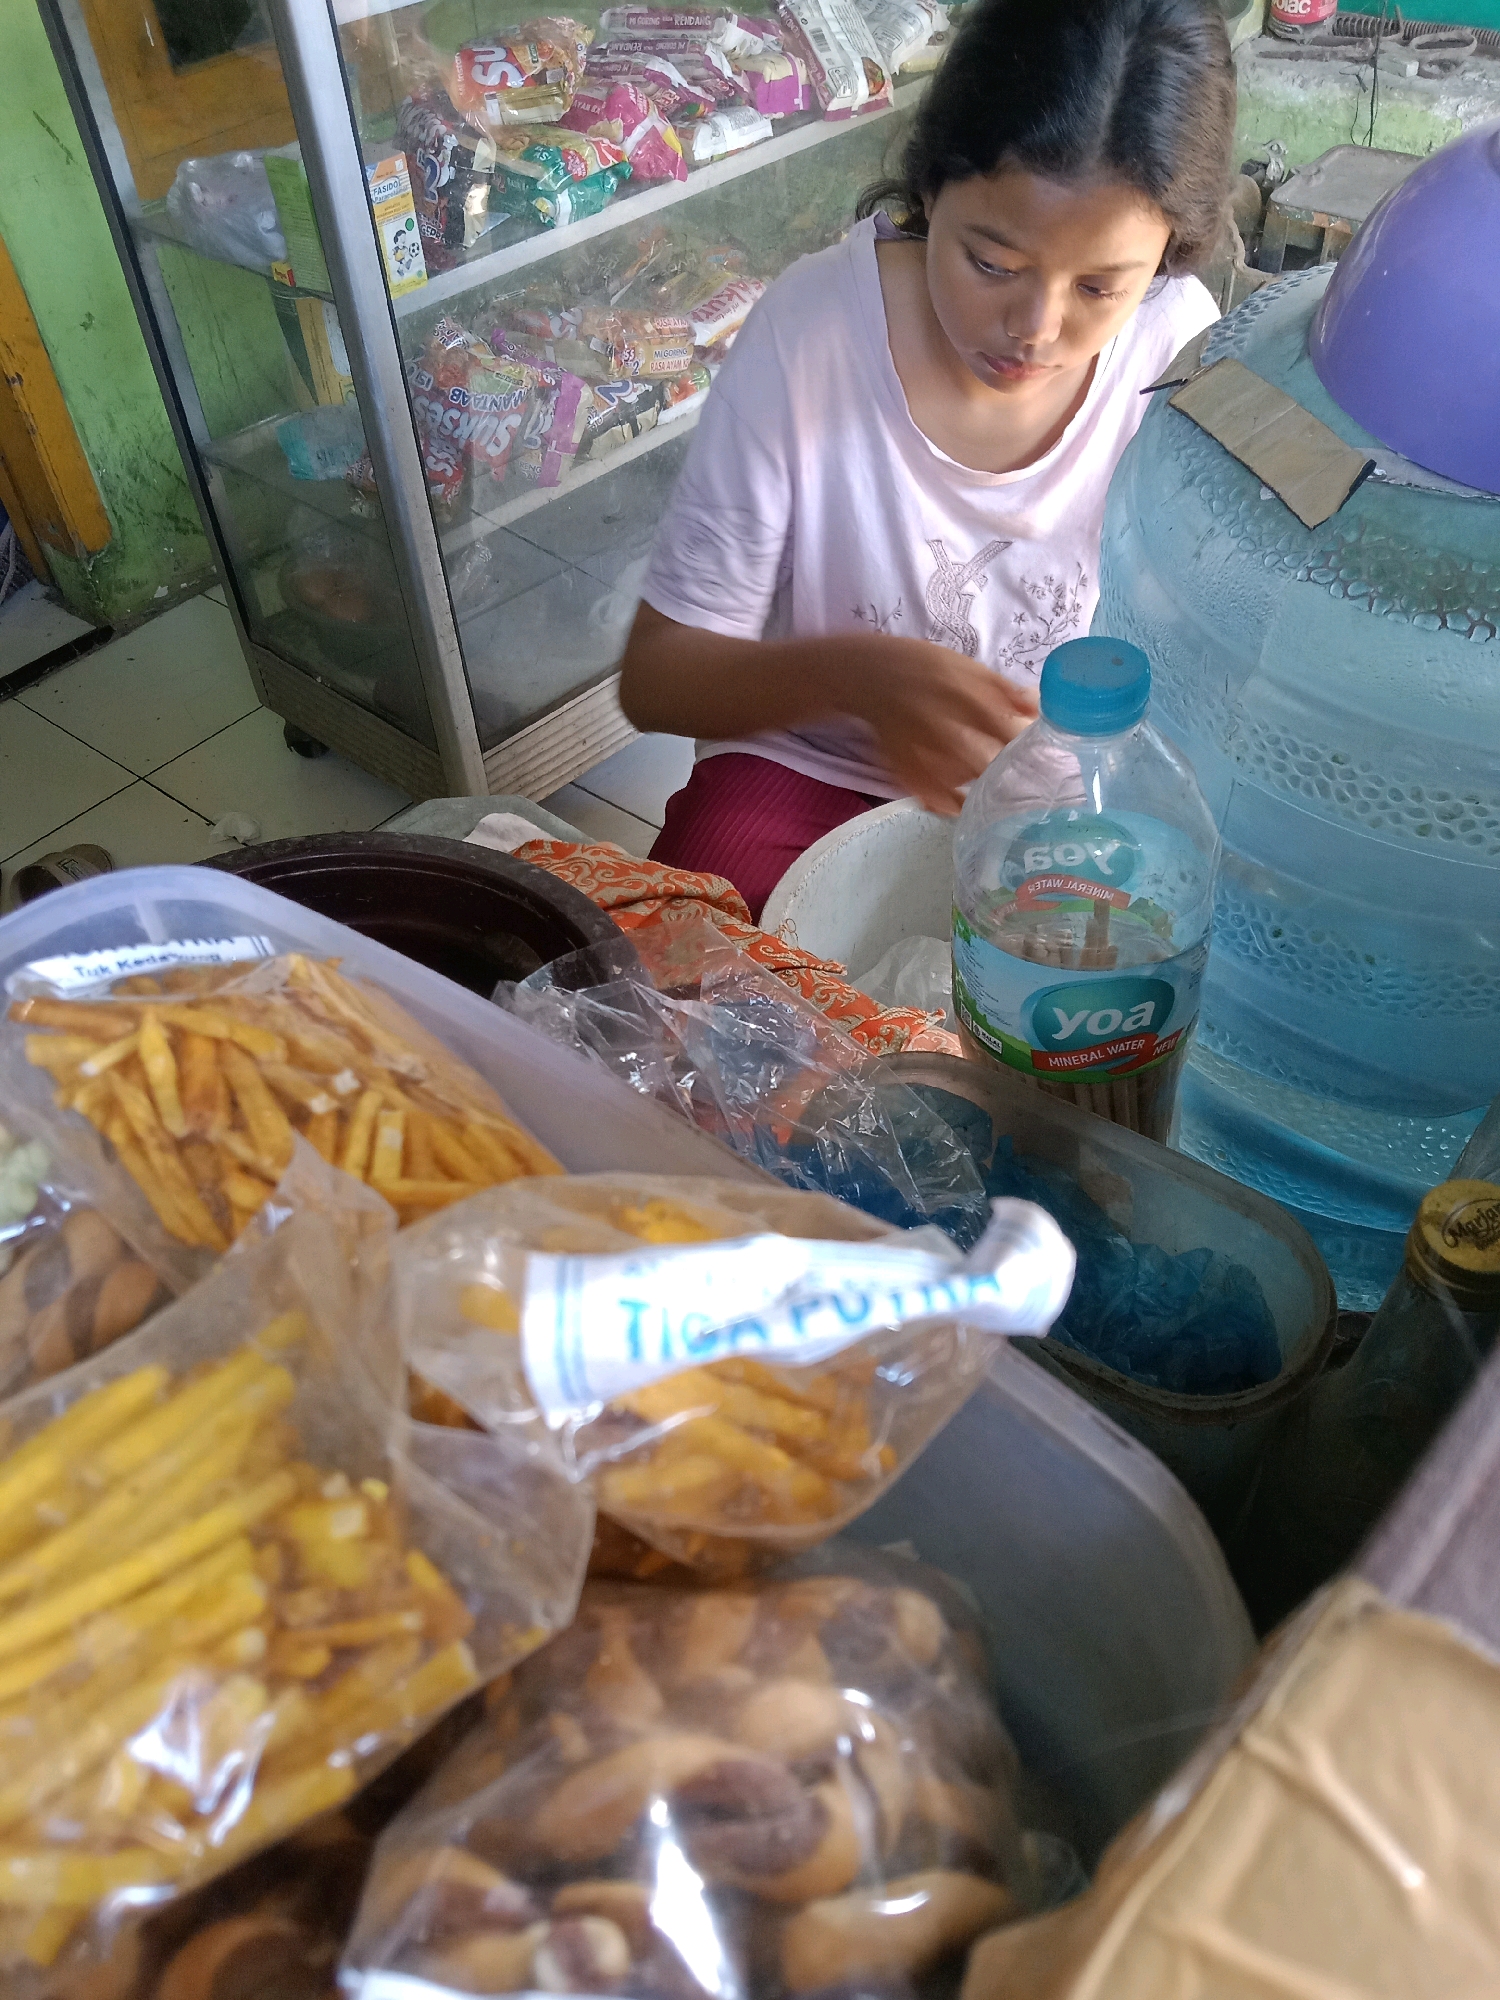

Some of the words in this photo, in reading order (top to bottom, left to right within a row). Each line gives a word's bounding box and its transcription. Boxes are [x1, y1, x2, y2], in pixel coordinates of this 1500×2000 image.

[674, 14, 712, 26] RENDANG
[663, 347, 688, 358] GORENG
[1051, 1000, 1156, 1041] yoa
[1048, 1048, 1105, 1068] MINERAL
[1105, 1039, 1145, 1060] WATER
